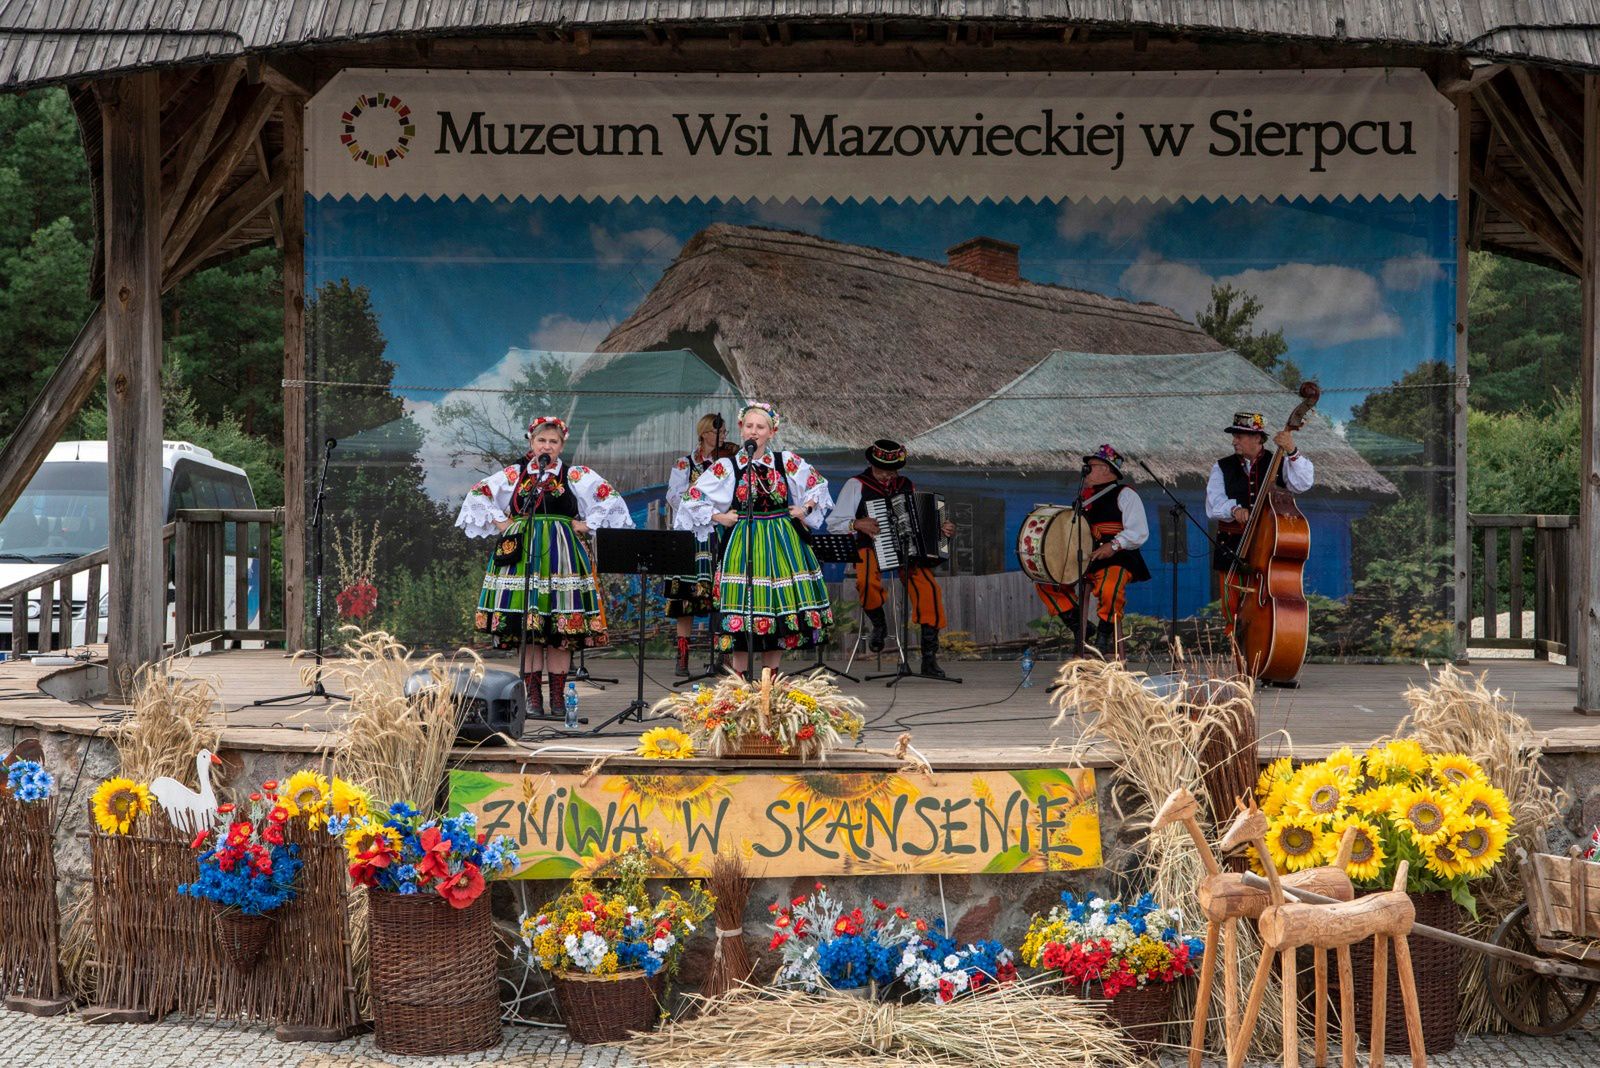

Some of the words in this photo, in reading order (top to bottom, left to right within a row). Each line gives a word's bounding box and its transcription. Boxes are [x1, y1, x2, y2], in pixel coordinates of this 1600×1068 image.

[436, 110, 663, 156] Muzeum
[672, 112, 773, 156] Wsi
[788, 109, 1125, 171] Mazowieckiej
[1139, 123, 1195, 157] w
[1209, 109, 1417, 173] Sierpcu
[682, 797, 730, 855] W
[752, 790, 1084, 860] SKANSENIE
